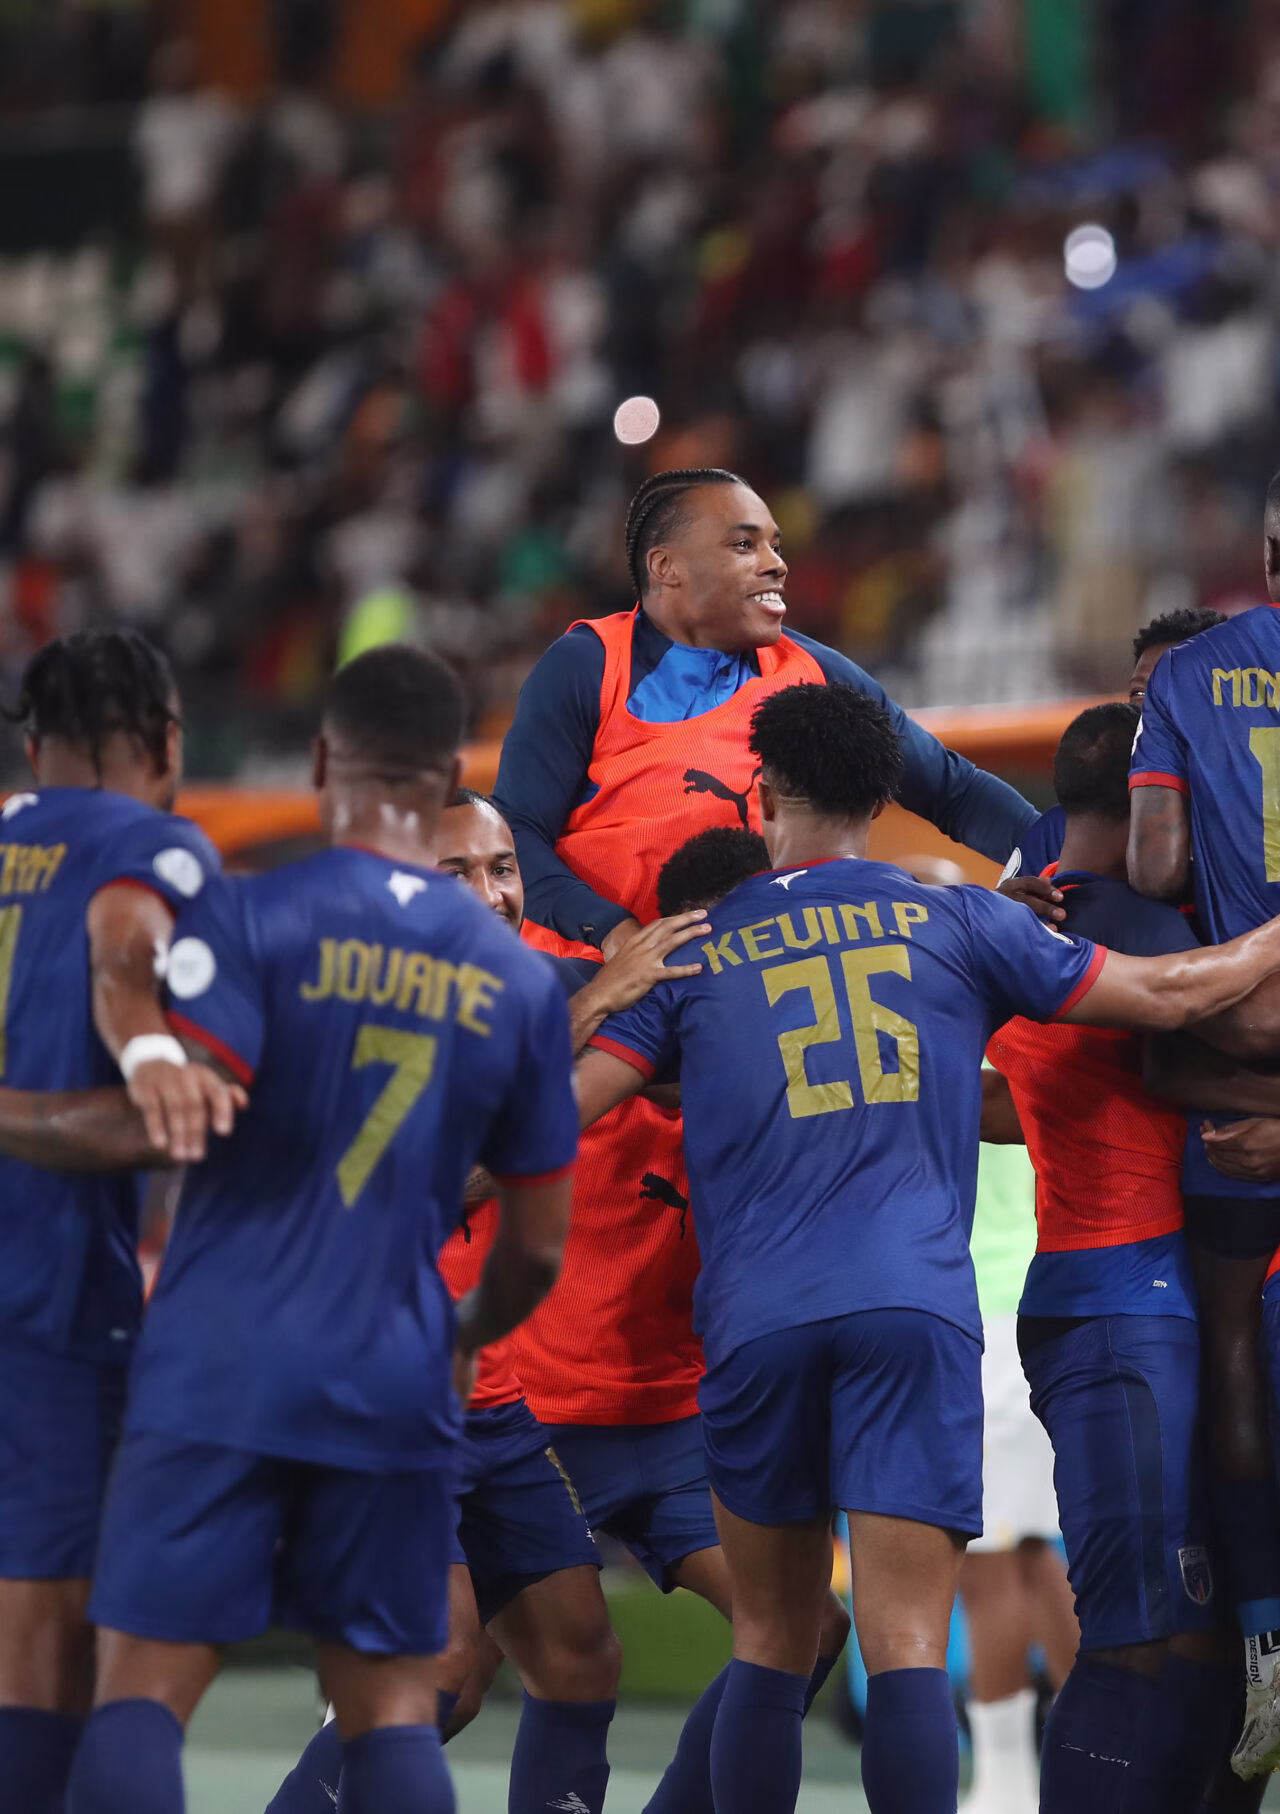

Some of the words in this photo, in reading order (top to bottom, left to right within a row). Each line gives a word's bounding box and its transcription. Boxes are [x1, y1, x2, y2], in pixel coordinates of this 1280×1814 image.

[336, 1024, 438, 1209] 7
[761, 944, 920, 1119] 26
[1250, 1637, 1262, 1684] DESIGN
